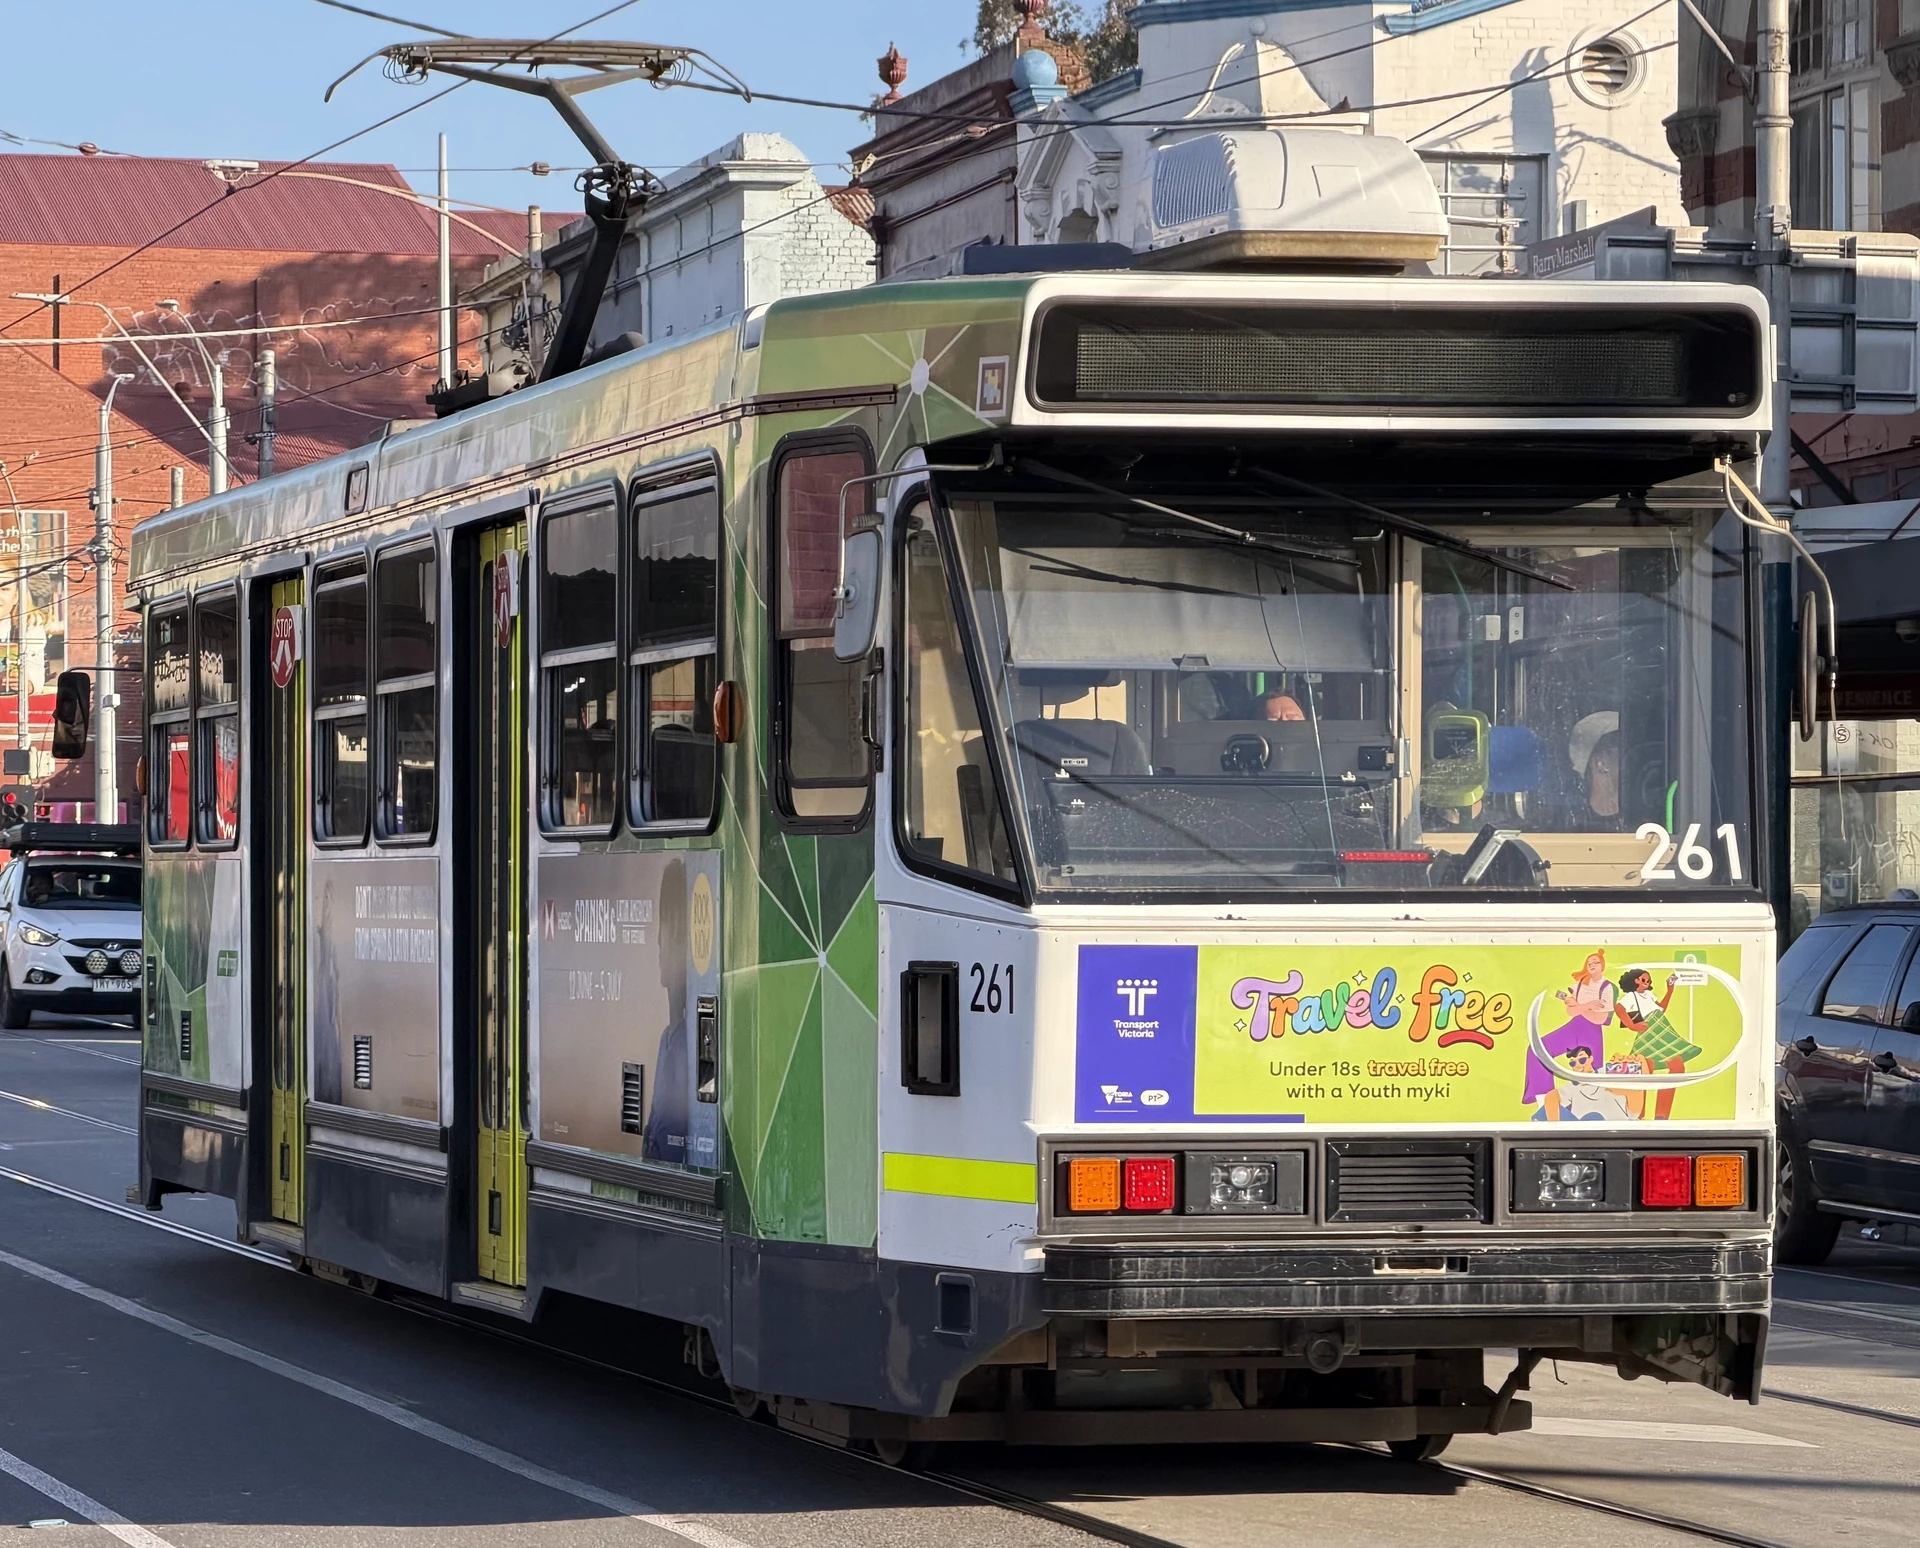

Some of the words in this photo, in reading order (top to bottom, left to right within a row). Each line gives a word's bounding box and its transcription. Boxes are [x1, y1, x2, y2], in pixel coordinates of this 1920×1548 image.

[275, 618, 293, 638] STOP
[1635, 822, 1742, 880] 261
[574, 899, 609, 942] SPANISH
[611, 907, 616, 942] &
[970, 962, 1014, 1014] 261
[1231, 967, 1400, 1041] Travel
[1409, 964, 1513, 1042] free
[1113, 1020, 1159, 1030] Transport
[1118, 1029, 1155, 1038] Victoria
[1270, 1061, 1326, 1076] Under
[1332, 1061, 1360, 1076] 18s
[1367, 1058, 1426, 1077] travel
[1428, 1058, 1469, 1077] free
[1286, 1084, 1325, 1098] with
[1331, 1087, 1342, 1098] a
[1349, 1084, 1400, 1098] Youth
[1406, 1083, 1450, 1102] myki
